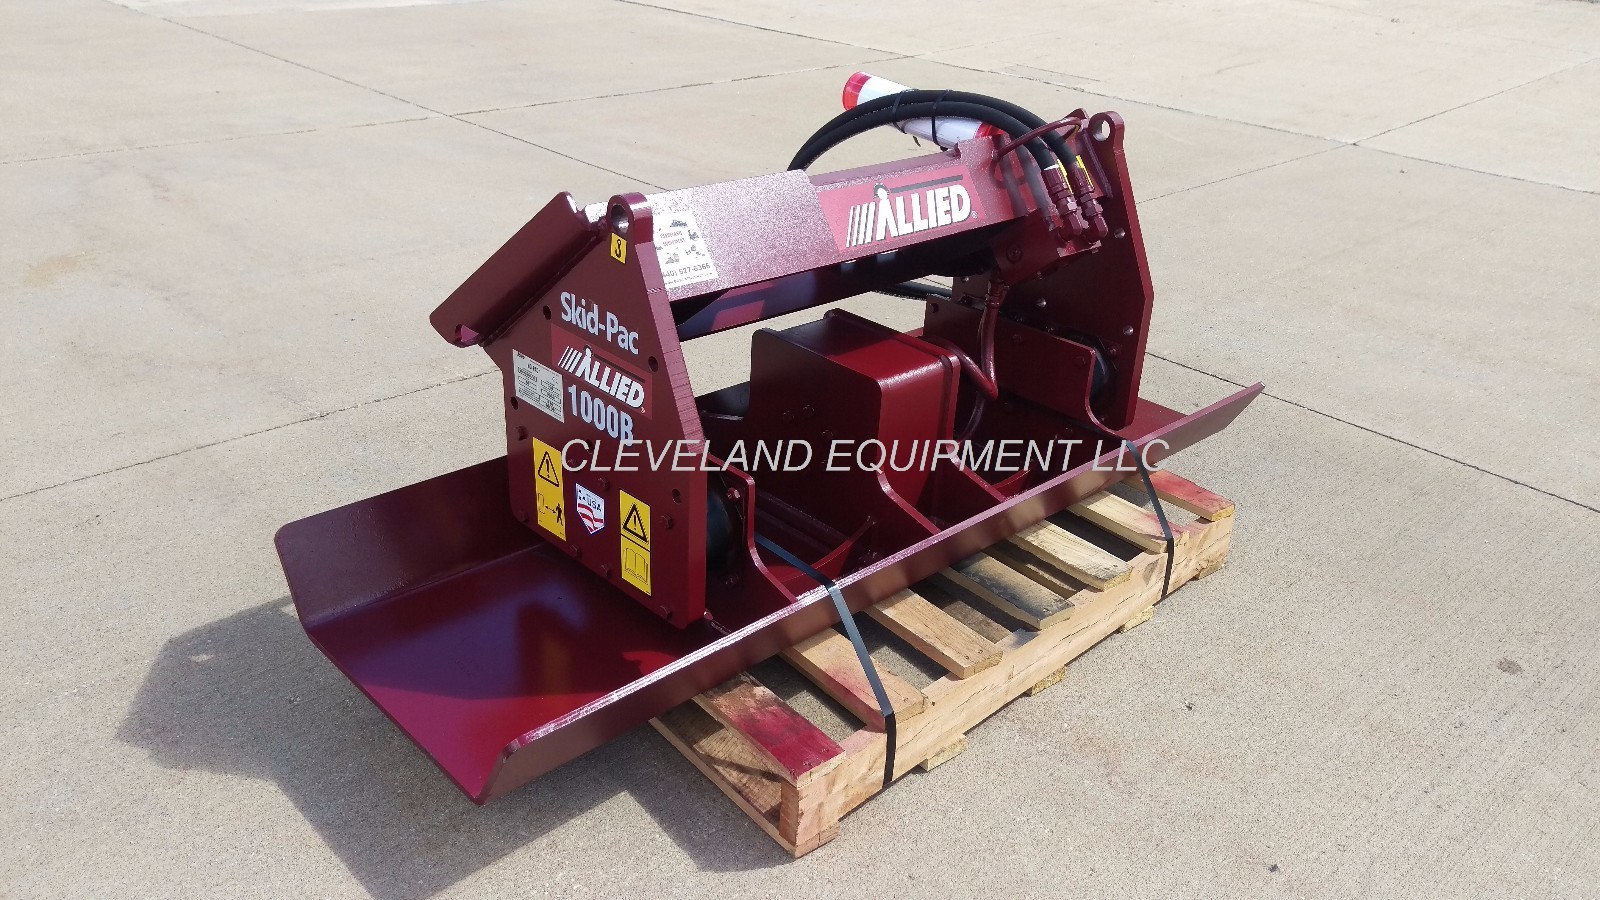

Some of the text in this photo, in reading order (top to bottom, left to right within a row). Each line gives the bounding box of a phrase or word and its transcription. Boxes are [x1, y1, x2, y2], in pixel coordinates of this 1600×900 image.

[876, 184, 971, 241] ALLIED
[560, 291, 639, 355] Skid-Pac
[577, 346, 645, 410] ALLIED
[568, 383, 634, 447] 1000B
